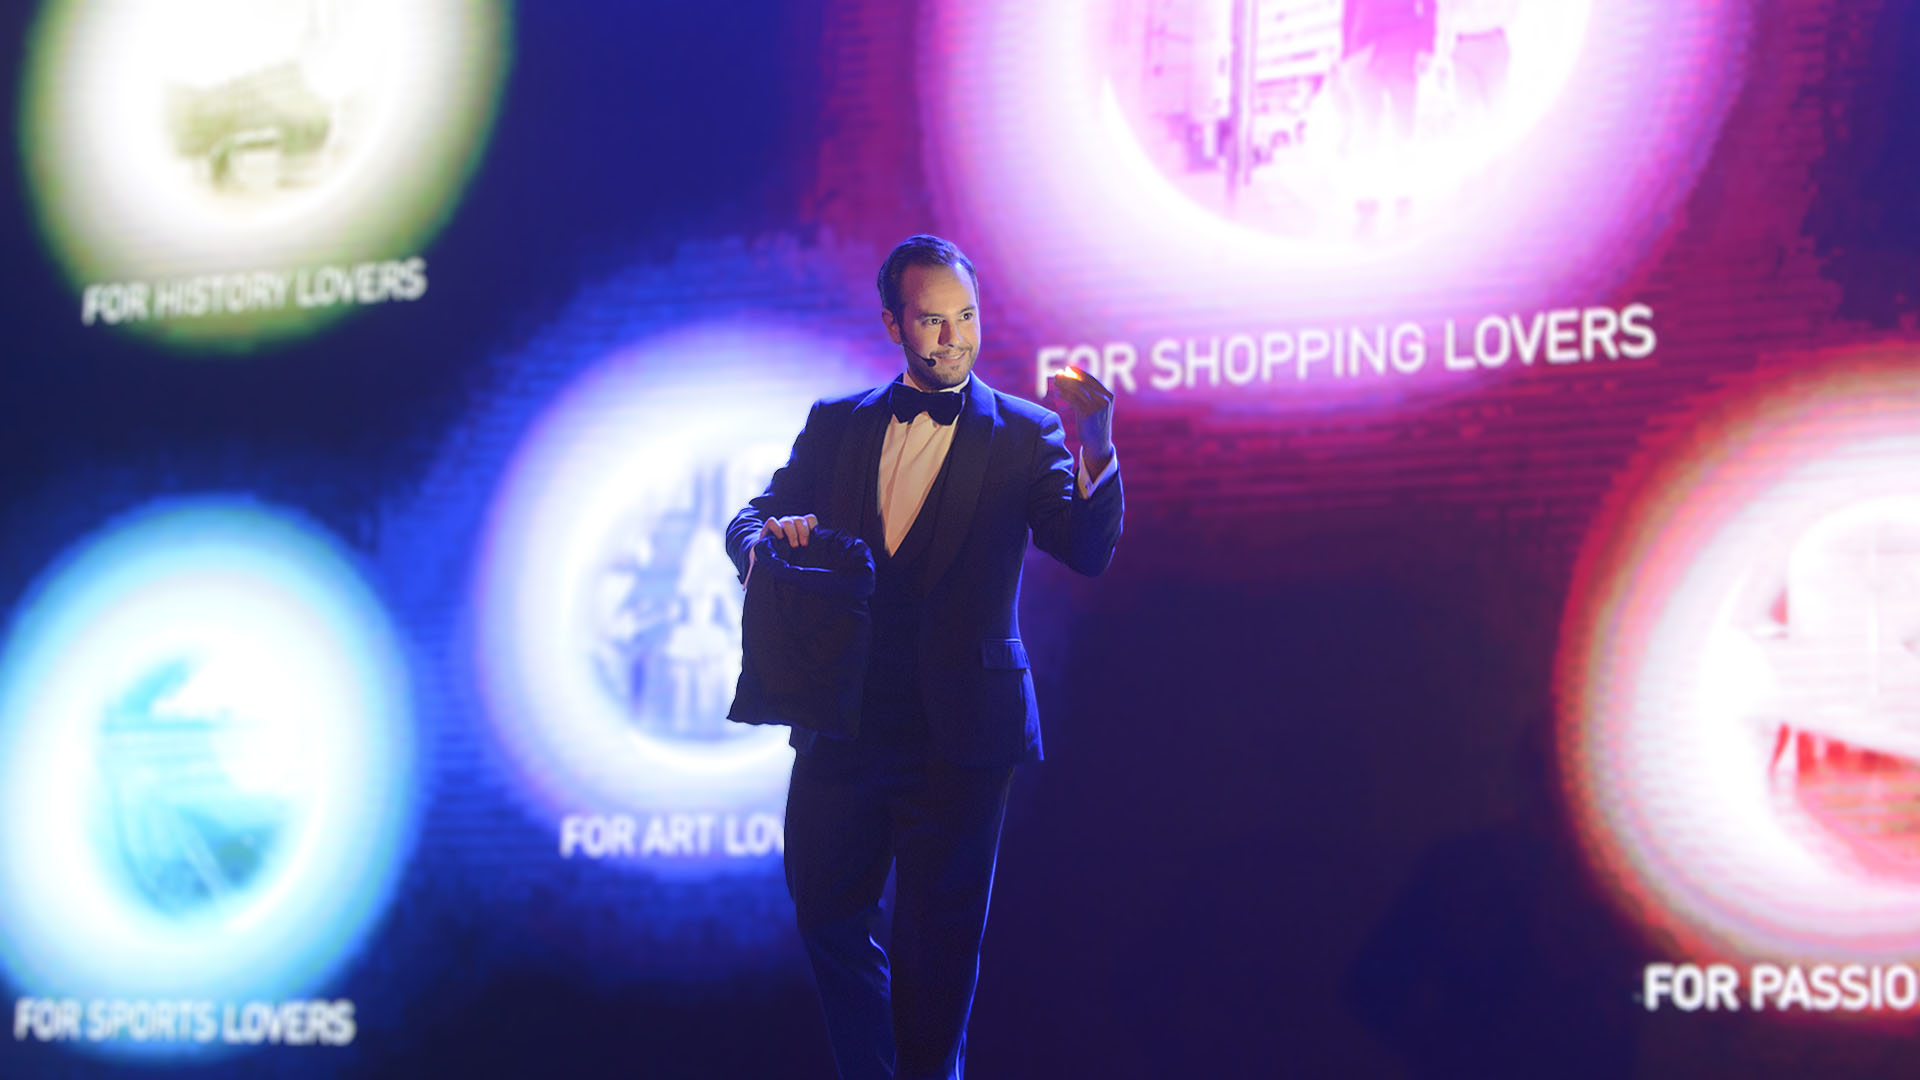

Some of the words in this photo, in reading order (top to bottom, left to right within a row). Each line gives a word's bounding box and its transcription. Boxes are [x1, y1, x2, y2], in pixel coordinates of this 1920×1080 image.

[82, 283, 150, 326] FOR
[155, 273, 286, 318] HISTORY
[299, 257, 428, 307] LOVERS
[1149, 322, 1426, 390] SHOPPING
[1444, 304, 1657, 370] LOVERS
[559, 813, 637, 859] FOR
[642, 814, 718, 856] ART
[1644, 962, 1740, 1012] FOR
[1751, 962, 1918, 1012] PASSIO
[13, 996, 82, 1042] FOR
[85, 997, 217, 1044] SPORTS
[222, 998, 356, 1046] LOVERS
